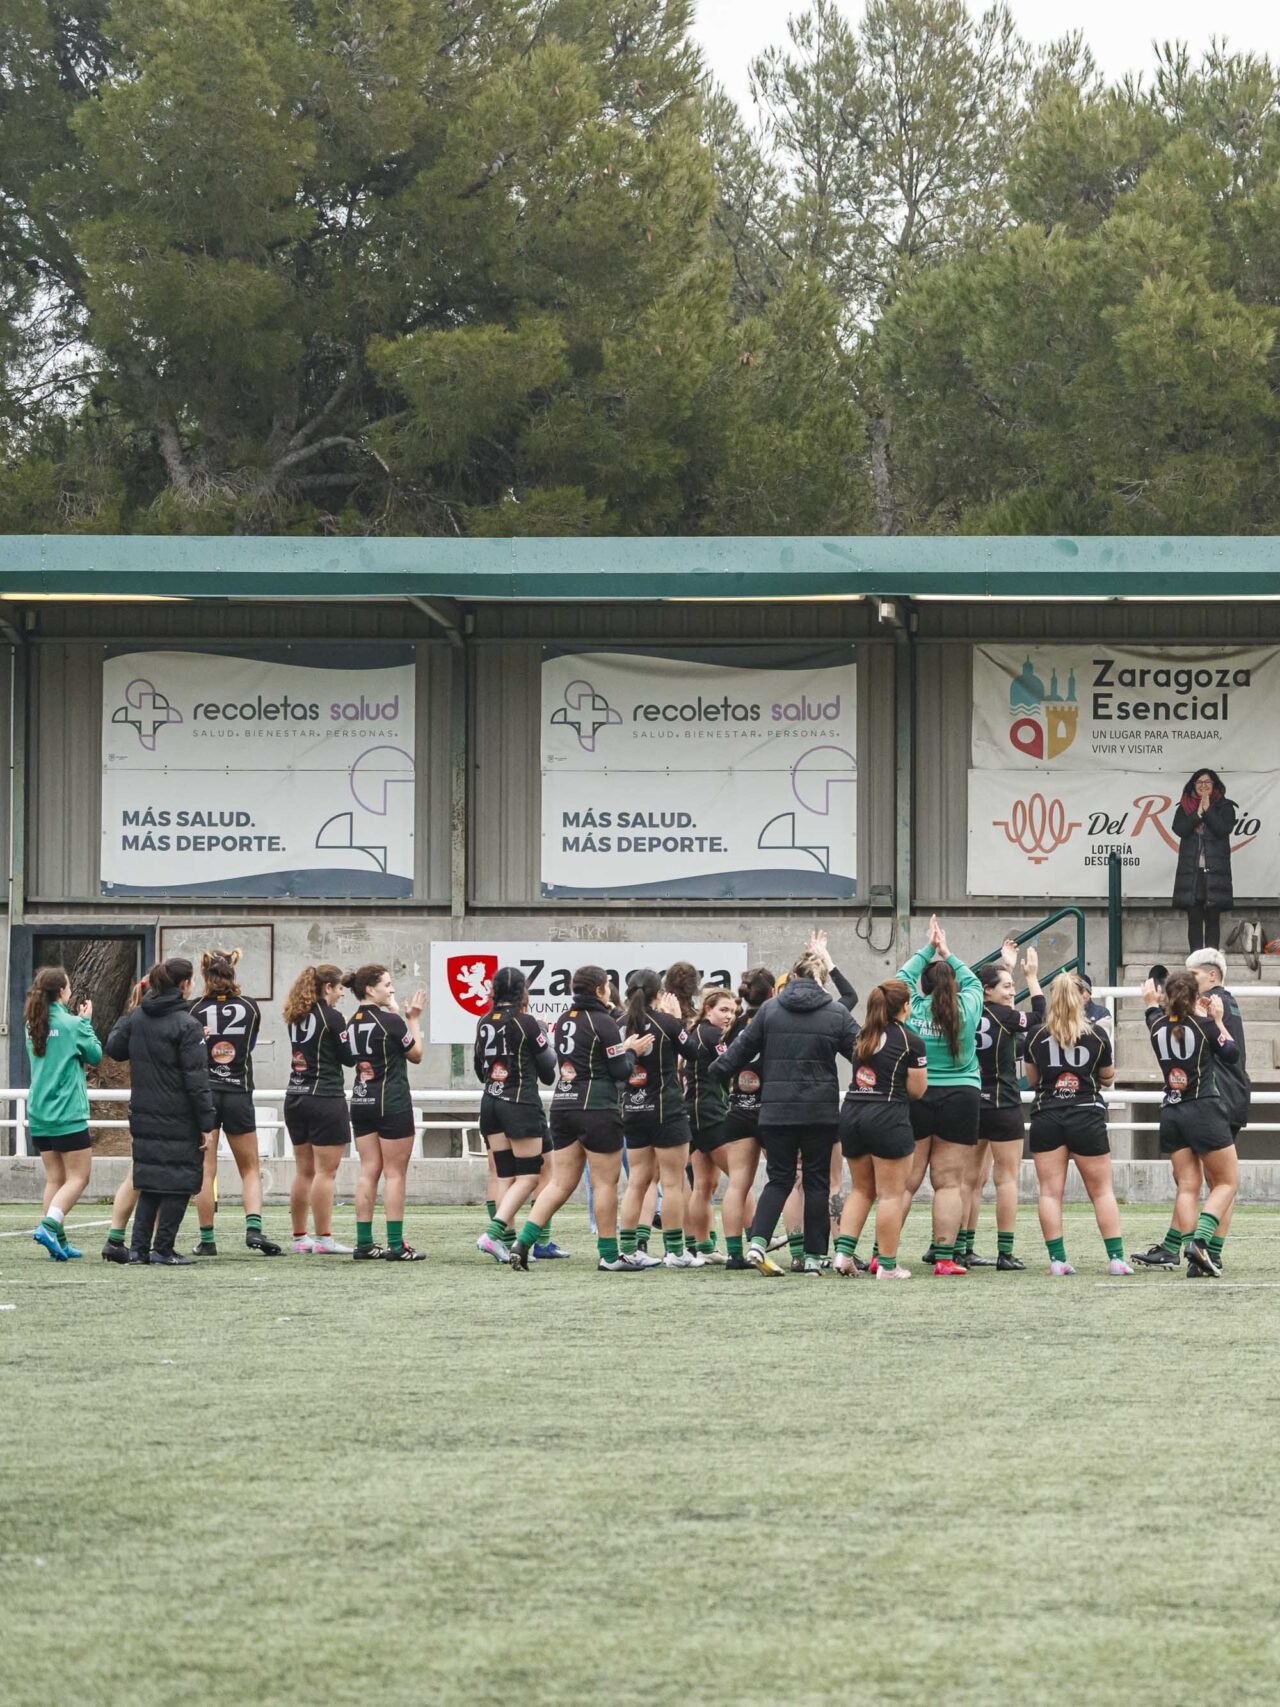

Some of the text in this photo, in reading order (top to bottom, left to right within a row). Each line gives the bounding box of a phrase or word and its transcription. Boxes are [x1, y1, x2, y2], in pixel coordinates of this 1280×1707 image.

[1092, 659, 1251, 695] Zaragoza
[192, 694, 399, 721] recoletas salud
[632, 695, 841, 722] recoletas salud
[1092, 692, 1229, 721] Esencial
[1092, 730, 1223, 742] UN LUGAR PARA TRABAJAR,
[1092, 744, 1163, 754] VIVIR Y VISITAR
[122, 806, 256, 827] MÁS SALUD.
[562, 808, 697, 829] MÁS SALUD.
[1087, 812, 1129, 836] Del
[121, 831, 287, 852] MÁS DEPORTE.
[562, 832, 728, 853] MÁS DEPORTE.
[1091, 843, 1133, 855] LOTERÍA
[1084, 856, 1110, 866] DESD
[198, 1003, 247, 1035] 12
[347, 1022, 377, 1056] 17
[559, 1020, 577, 1055] 3
[1152, 1025, 1196, 1061] 10
